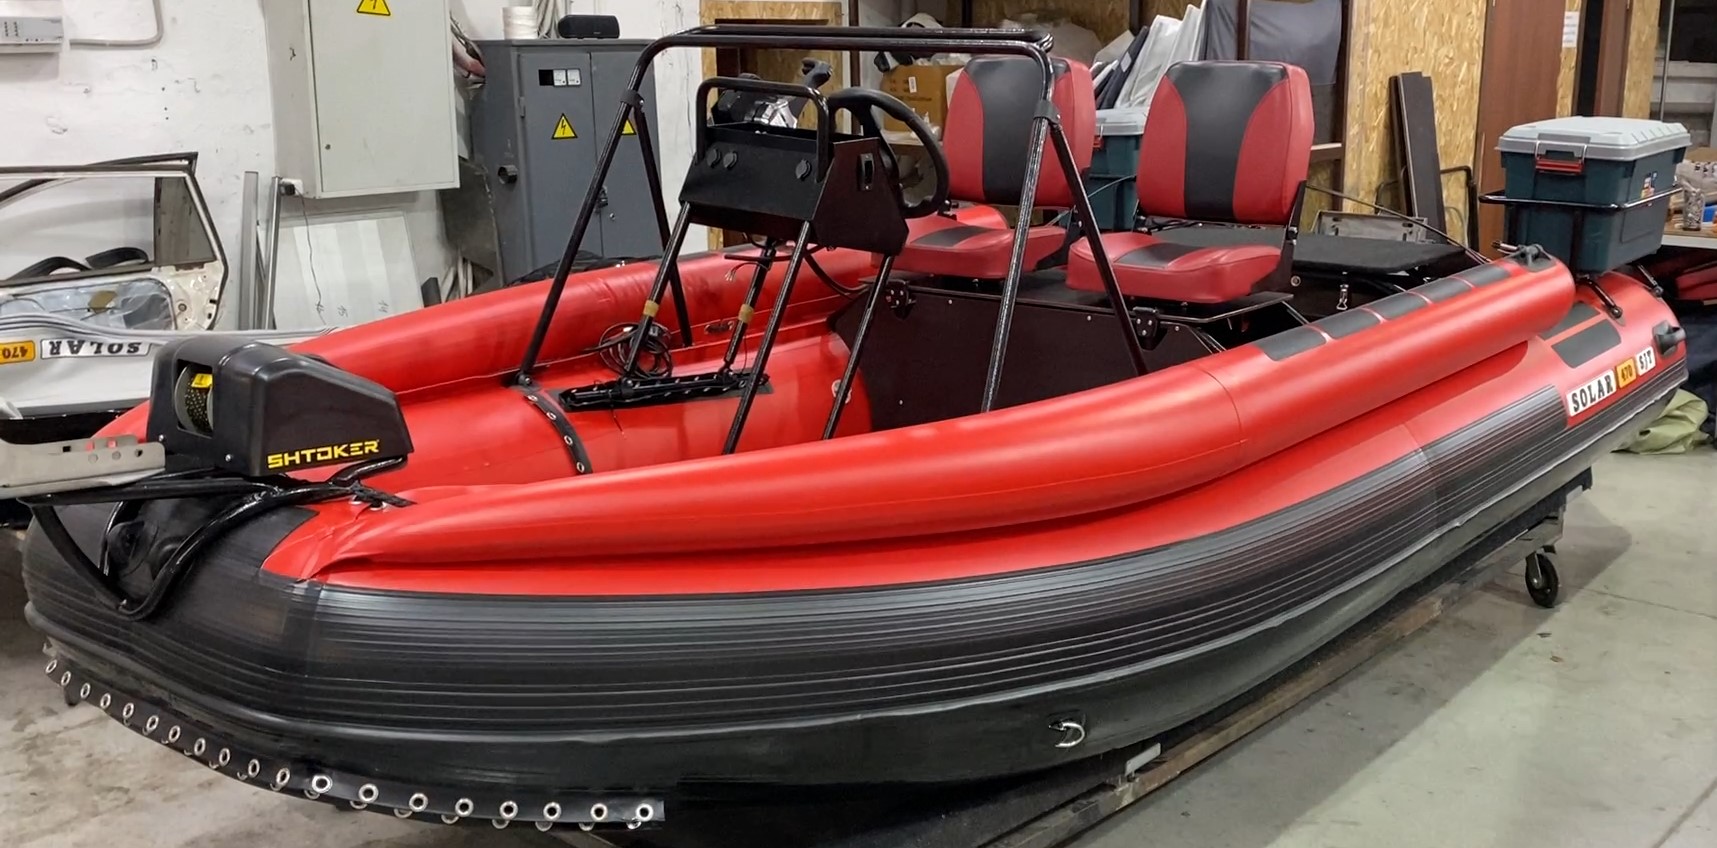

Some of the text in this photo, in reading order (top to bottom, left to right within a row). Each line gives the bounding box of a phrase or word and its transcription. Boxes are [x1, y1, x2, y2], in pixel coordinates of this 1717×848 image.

[2, 340, 142, 359] SOLAR 470
[1571, 375, 1613, 412] SOLAR
[1621, 364, 1633, 381] 470
[267, 440, 380, 470] SHTOKER
